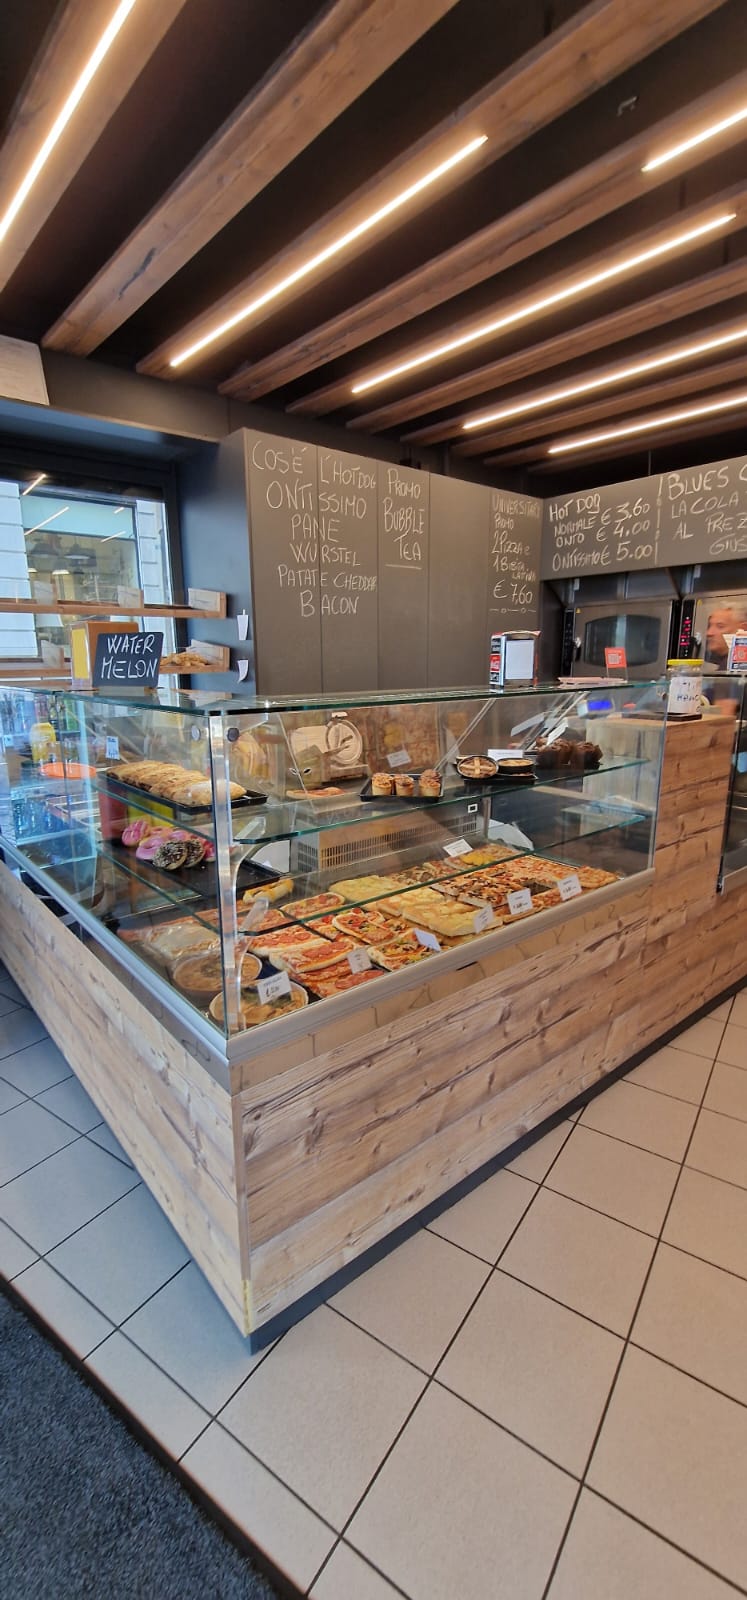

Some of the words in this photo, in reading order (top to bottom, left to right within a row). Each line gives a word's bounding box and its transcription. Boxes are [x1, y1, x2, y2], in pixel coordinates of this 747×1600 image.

[387, 467, 421, 500] PROMO
[668, 465, 729, 501] BLUES
[266, 478, 367, 520] ONTISSIMO
[549, 499, 574, 523] HOT
[671, 500, 687, 520] LA
[689, 491, 739, 515] COLA
[291, 513, 340, 543] PANE
[382, 496, 425, 535] BUBBLE
[554, 515, 597, 539] NORMALE
[600, 507, 612, 526] €
[556, 533, 585, 548] ONTO
[596, 526, 608, 542] €
[673, 521, 694, 542] AL
[289, 542, 361, 567] WURSTEL
[394, 533, 422, 561] TEA
[277, 563, 329, 589] PATATE
[493, 579, 508, 599] €
[300, 589, 359, 617] BACON
[107, 633, 155, 655] WATER
[100, 658, 158, 679] MELON
